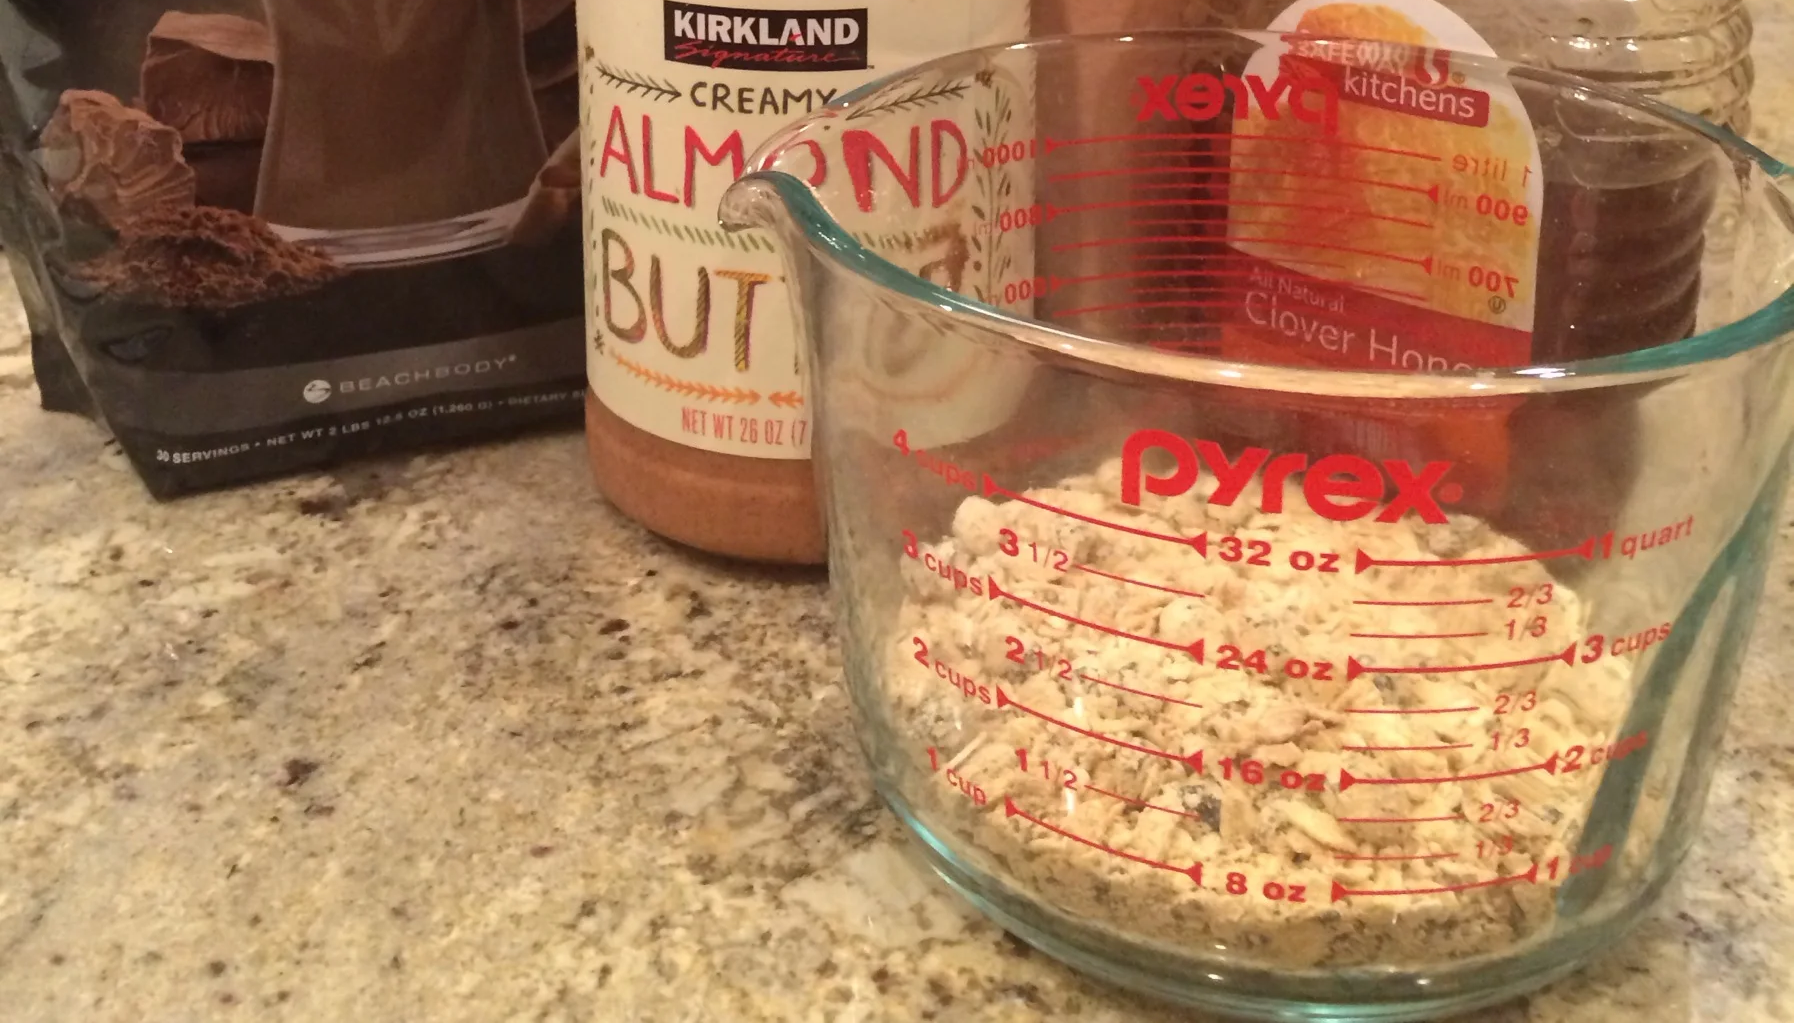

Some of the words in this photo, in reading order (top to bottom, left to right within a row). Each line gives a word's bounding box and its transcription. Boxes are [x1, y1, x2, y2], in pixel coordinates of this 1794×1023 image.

[674, 9, 860, 46] KIRKLAND
[674, 39, 850, 69] Signature
[690, 81, 838, 116] CREAMY
[1344, 65, 1476, 119] kitchens
[600, 105, 968, 213] ALMOND
[1252, 267, 1273, 290] All
[1277, 278, 1345, 314] Natural
[1245, 291, 1355, 354] Clover
[1369, 329, 1475, 372] Hon
[338, 357, 510, 394] BEACHBODY
[156, 449, 169, 463] 30
[172, 442, 250, 465] SERVINGS
[266, 433, 297, 447] NET
[301, 428, 324, 440] WT
[328, 425, 337, 437] 2
[341, 421, 370, 435] LBS
[407, 407, 428, 419] OZ
[507, 390, 568, 406] DIETARY
[681, 406, 708, 437] NET
[713, 413, 734, 441] WT
[740, 417, 758, 444] 26
[764, 419, 784, 446] OZ
[915, 449, 977, 492] cups
[1121, 429, 1451, 524] pyrex
[999, 528, 1019, 558] 3
[1028, 542, 1069, 573] 1/2
[1218, 536, 1272, 568] 32
[1289, 550, 1340, 574] oz
[1600, 530, 1616, 559] 1
[1621, 515, 1695, 560] quart
[925, 553, 983, 596] cups
[1506, 583, 1553, 609] 2/3
[1504, 616, 1548, 642] 1/3
[1581, 634, 1605, 665] 3
[1611, 622, 1673, 657] cups
[912, 637, 929, 669] 2
[934, 660, 992, 705] cups
[1005, 636, 1026, 665] 2
[1034, 649, 1073, 682] 1/2
[1216, 644, 1268, 675] 24
[1284, 659, 1334, 681] oz
[1494, 689, 1537, 716] 2/3
[927, 746, 939, 771] 1
[946, 768, 987, 806] cup
[1015, 748, 1028, 773] 1
[1218, 757, 1265, 786] 16
[1280, 770, 1328, 792] oz
[1561, 745, 1585, 774] 2
[1226, 871, 1249, 896] 8
[1262, 881, 1307, 904] oz
[1547, 856, 1561, 881] 1
